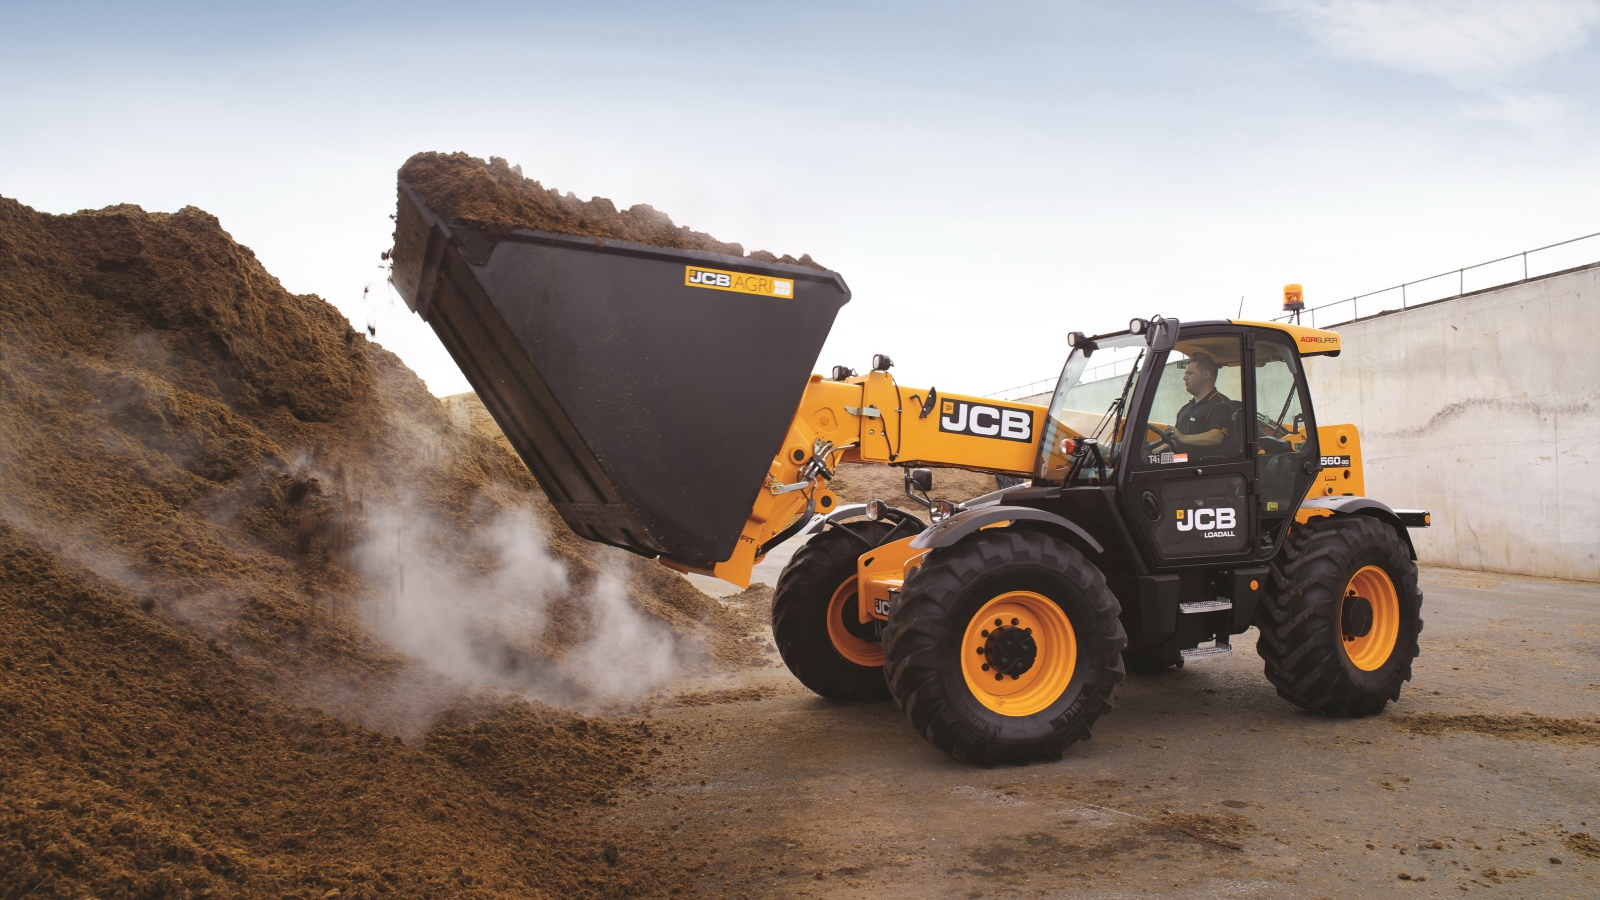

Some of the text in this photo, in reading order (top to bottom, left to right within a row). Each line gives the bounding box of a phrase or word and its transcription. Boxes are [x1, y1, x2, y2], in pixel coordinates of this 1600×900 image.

[689, 271, 772, 293] JCB AGRI
[941, 403, 1030, 440] JCB
[1176, 507, 1237, 532] JCB
[1204, 530, 1236, 539] LOADALL
[875, 600, 890, 616] JC
